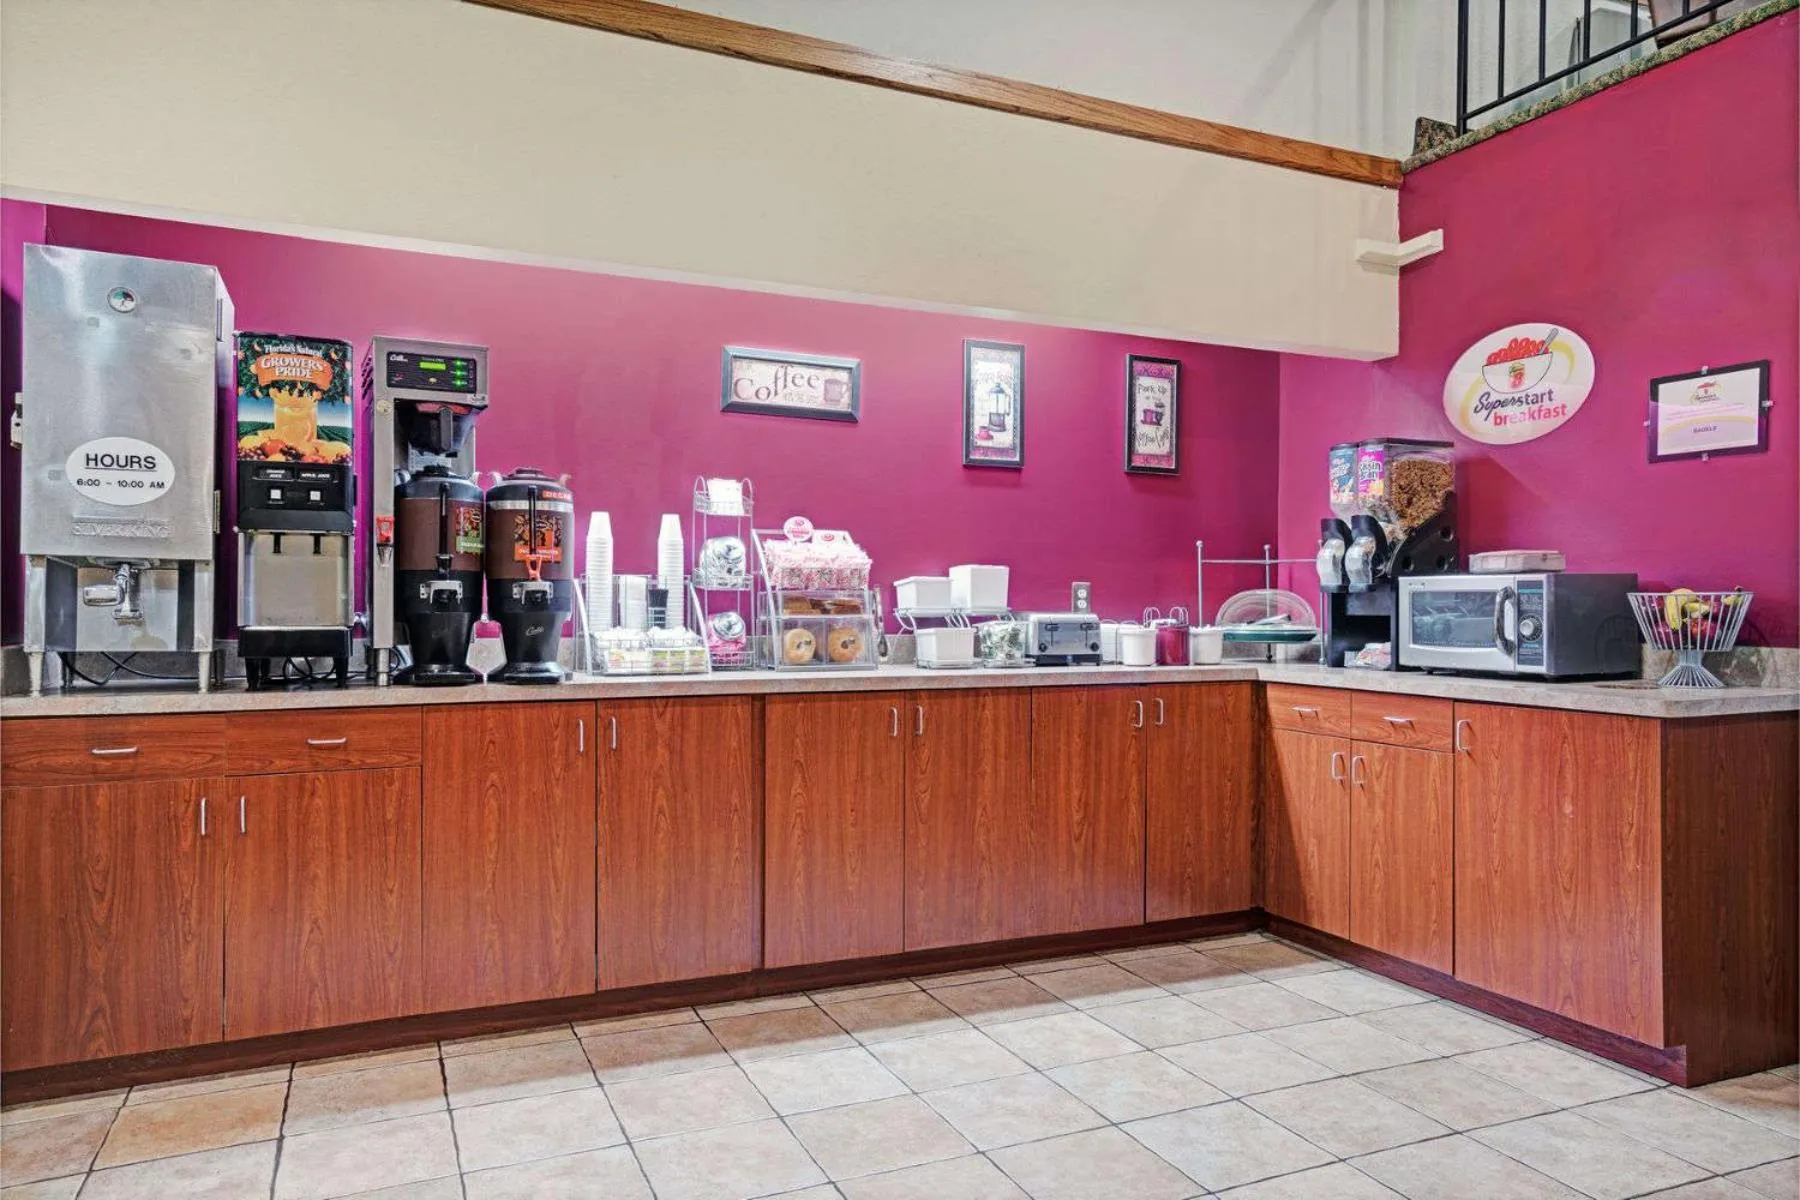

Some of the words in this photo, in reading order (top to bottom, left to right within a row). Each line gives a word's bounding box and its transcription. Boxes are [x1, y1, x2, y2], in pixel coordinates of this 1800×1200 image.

[275, 367, 313, 379] PRIDE
[734, 363, 820, 400] Coffee
[1473, 389, 1554, 421] Superstart
[1493, 403, 1567, 426] breakfast
[86, 453, 156, 470] HOURS
[77, 478, 100, 487] 6:00
[118, 480, 144, 488] 10:00
[149, 481, 165, 489] AM
